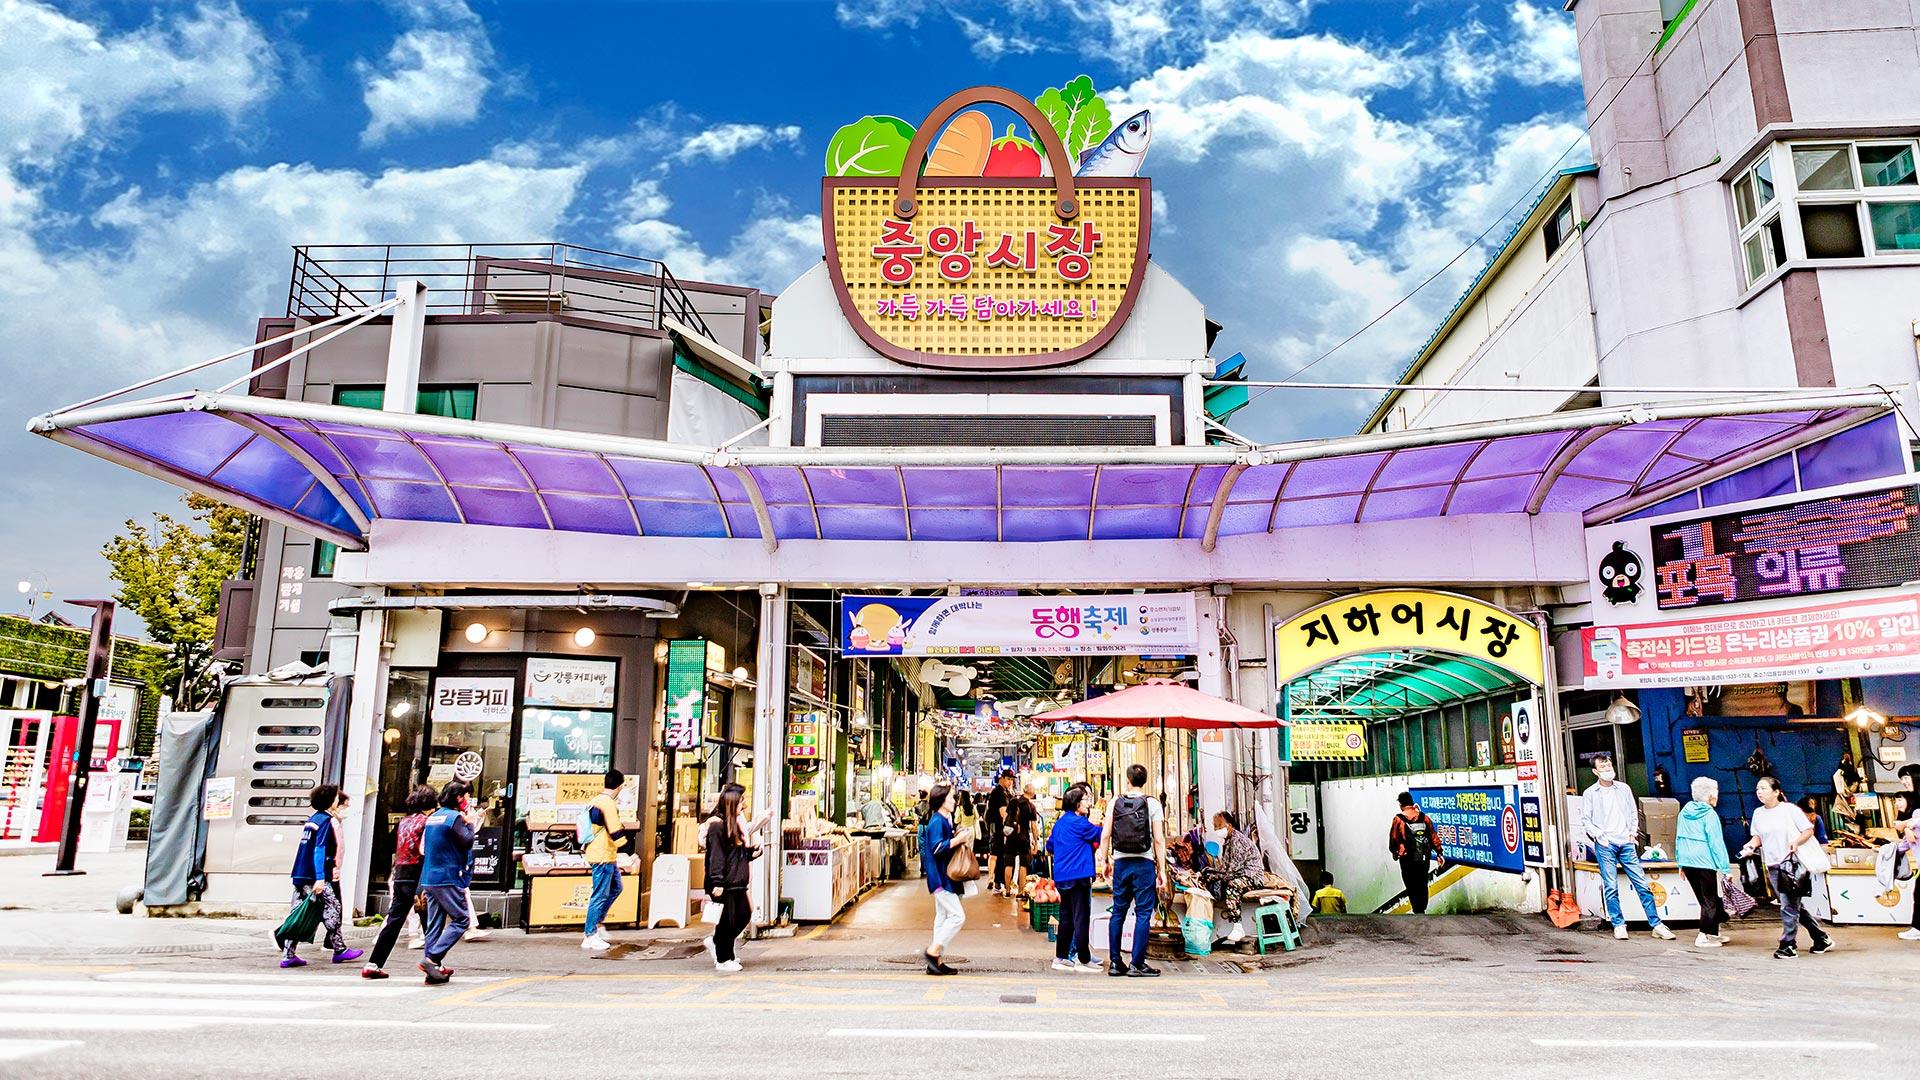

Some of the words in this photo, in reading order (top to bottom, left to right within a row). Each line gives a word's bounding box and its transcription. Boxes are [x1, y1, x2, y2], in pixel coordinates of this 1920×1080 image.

[872, 218, 1102, 284] 중앙시장
[877, 295, 920, 320] 가득
[925, 295, 968, 320] 가득
[1754, 544, 1846, 593] 의류
[928, 608, 951, 636] 함께하면
[950, 601, 983, 613] 대박나는
[1030, 606, 1128, 639] 동행축제
[1300, 601, 1520, 658] 지하어시장
[1625, 638, 1671, 658] 충전식
[1674, 634, 1722, 656] 카드형
[1725, 624, 1829, 651] 온누리상품권
[1833, 619, 1875, 641] 10%
[1877, 613, 1920, 638] 할인
[1682, 625, 1702, 634] 이제는
[1767, 618, 1775, 626] 내
[1777, 616, 1798, 625] 카드로
[554, 672, 607, 686] 강릉커피빵
[440, 689, 508, 706] 강릉커피
